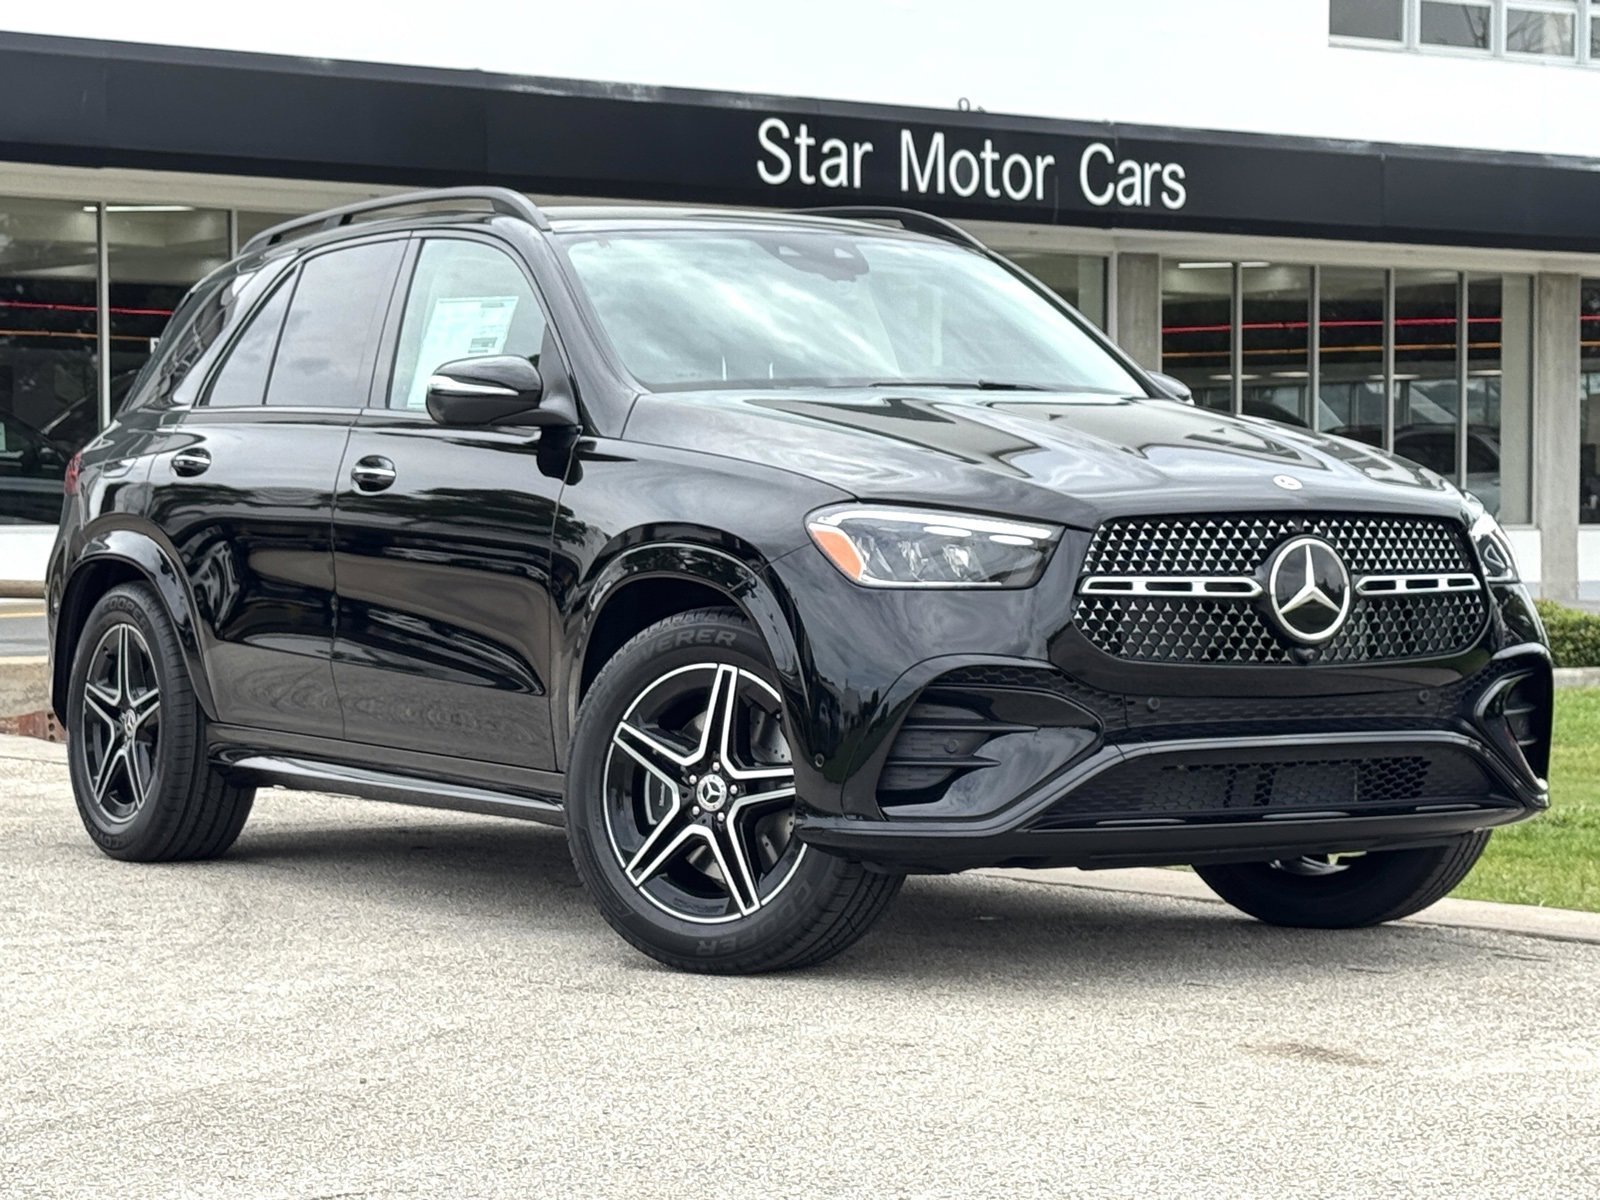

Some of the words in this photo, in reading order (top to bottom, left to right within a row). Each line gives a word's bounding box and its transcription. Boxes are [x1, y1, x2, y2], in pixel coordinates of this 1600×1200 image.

[756, 117, 873, 189] Star
[900, 128, 1055, 201] Motor
[1079, 142, 1187, 210] Cars
